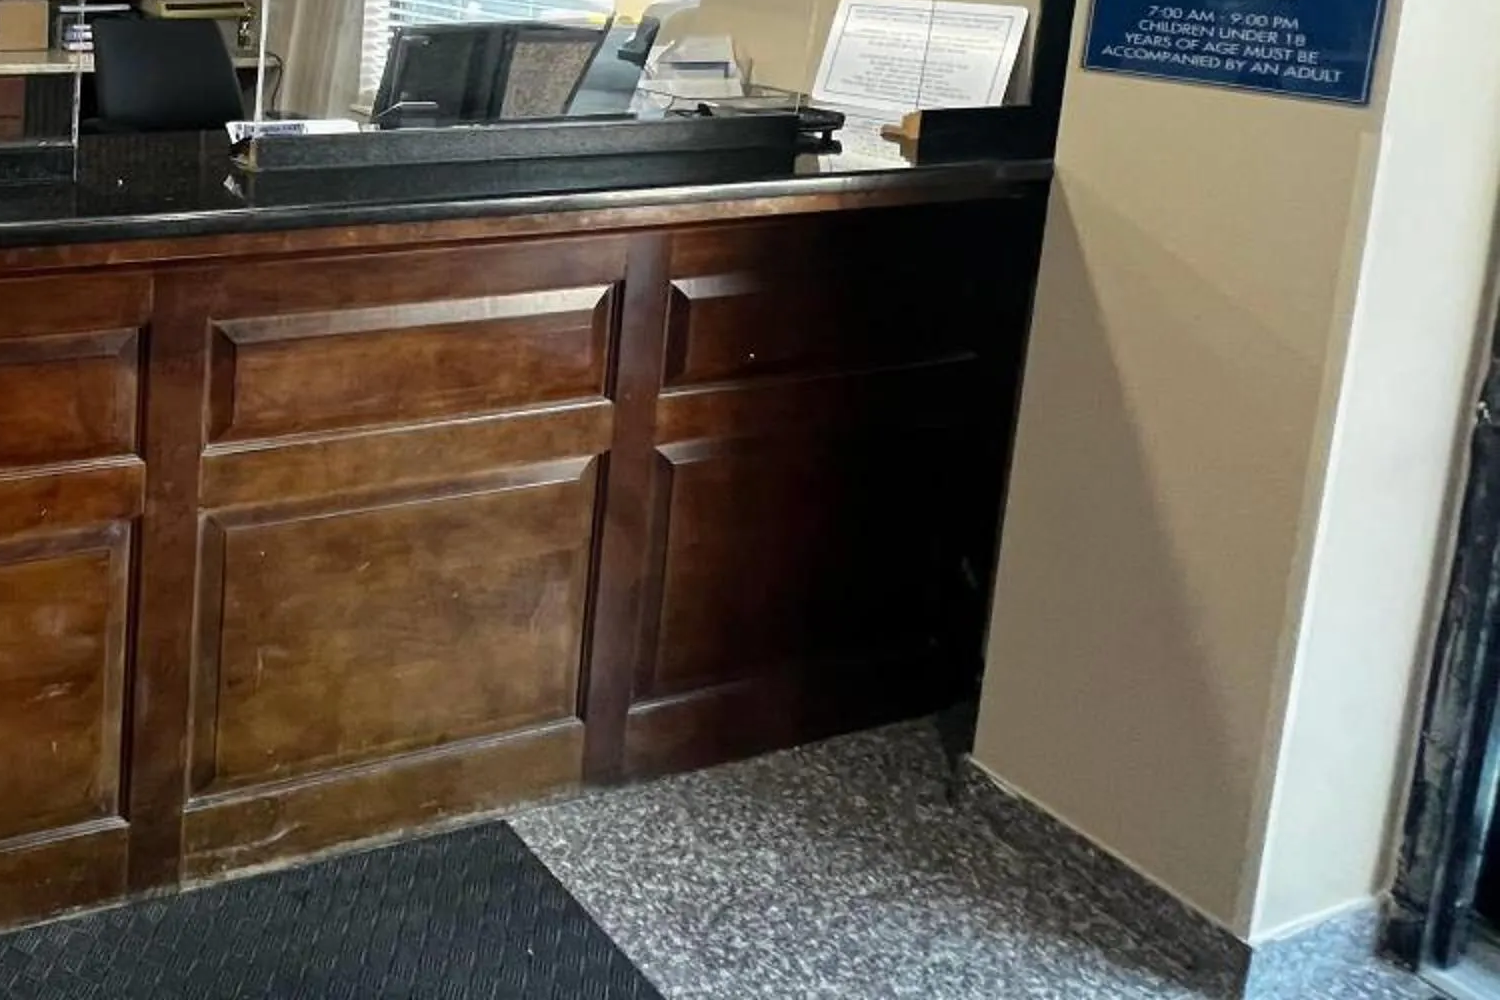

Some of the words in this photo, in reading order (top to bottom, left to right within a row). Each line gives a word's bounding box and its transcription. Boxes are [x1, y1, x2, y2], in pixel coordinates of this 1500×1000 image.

[1138, 19, 1215, 38] CHILDREN
[1219, 27, 1278, 45] UNDER
[1286, 33, 1306, 47] 18
[1187, 9, 1215, 22] AM
[1272, 16, 1299, 31] PM
[1101, 44, 1221, 69] ACCOMPANIED
[1225, 57, 1246, 73] BY
[1250, 61, 1279, 76] AN
[1283, 66, 1343, 83] ADULT
[1124, 32, 1172, 48] YEARS
[1175, 37, 1199, 50] OF
[1203, 42, 1239, 56] AGE
[1243, 44, 1295, 61] MUST
[1297, 50, 1320, 65] BE
